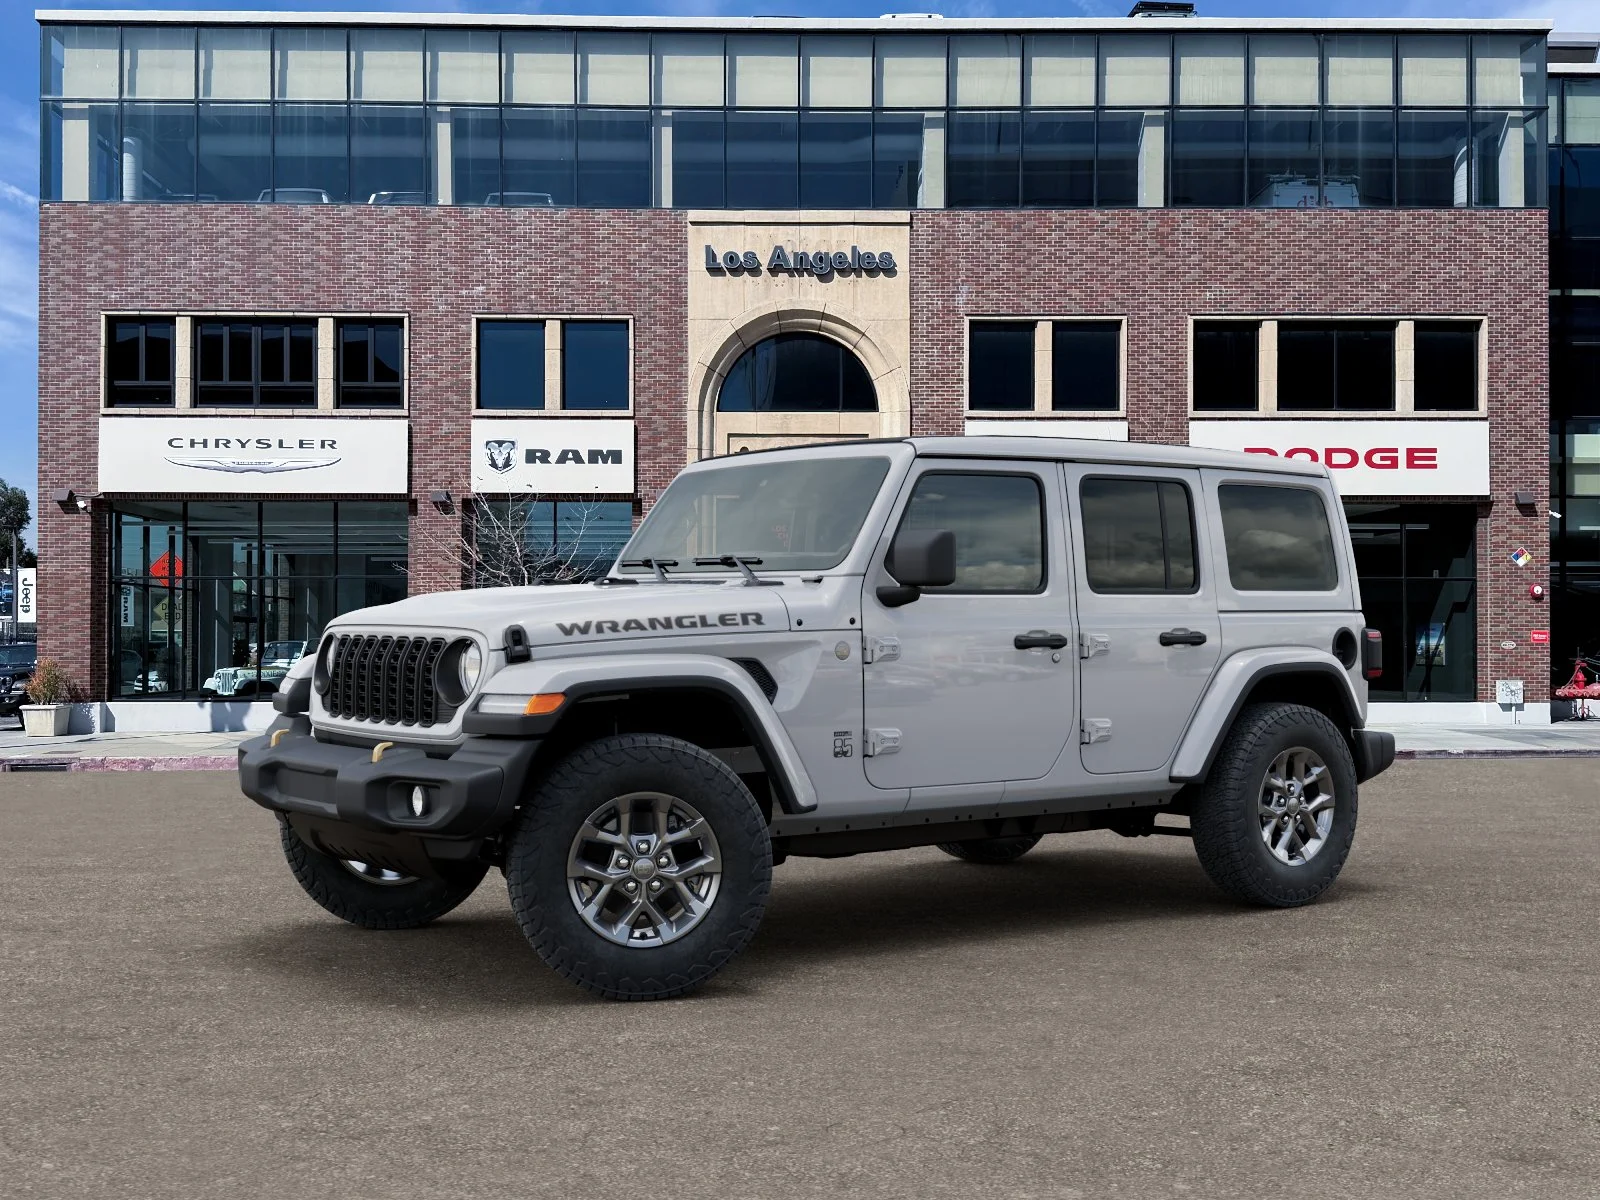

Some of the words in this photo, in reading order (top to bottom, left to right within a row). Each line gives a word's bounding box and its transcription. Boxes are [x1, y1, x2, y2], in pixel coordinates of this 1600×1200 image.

[705, 244, 758, 268] Los
[767, 245, 895, 275] Angeles
[167, 437, 338, 449] CHRYSLER
[525, 449, 622, 464] RAM
[20, 577, 33, 613] Jeep
[165, 612, 181, 620] ED
[556, 612, 765, 636] WRANGLER
